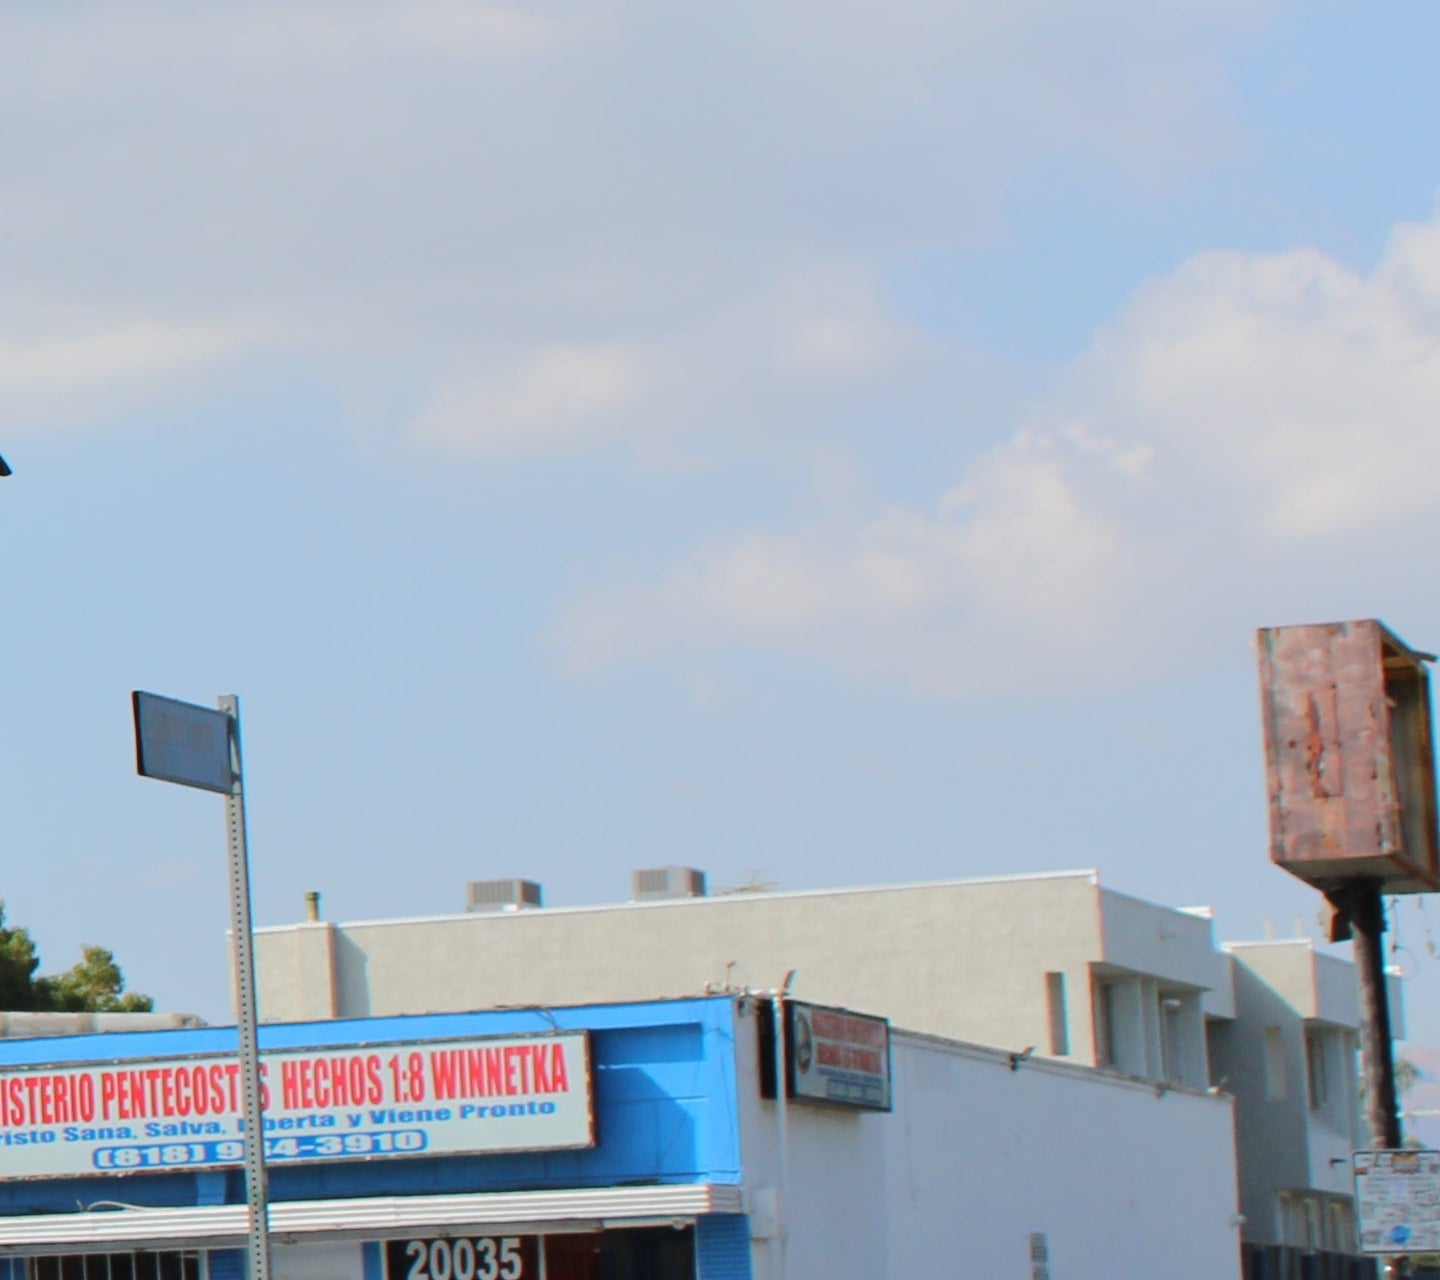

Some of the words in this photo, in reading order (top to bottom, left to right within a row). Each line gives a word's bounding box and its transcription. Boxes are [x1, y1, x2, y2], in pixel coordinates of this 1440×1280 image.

[102, 1064, 271, 1121] PENTECOSTS
[282, 1055, 383, 1110] HECHOS
[388, 1052, 424, 1103] 1:8
[431, 1043, 569, 1100] WINNETKA
[237, 1112, 335, 1132] Lberta
[348, 1114, 362, 1128] y
[369, 1107, 452, 1124] Viene
[460, 1101, 556, 1120] Pronto
[96, 1144, 204, 1168] (818)
[216, 1130, 422, 1160] 94-3910
